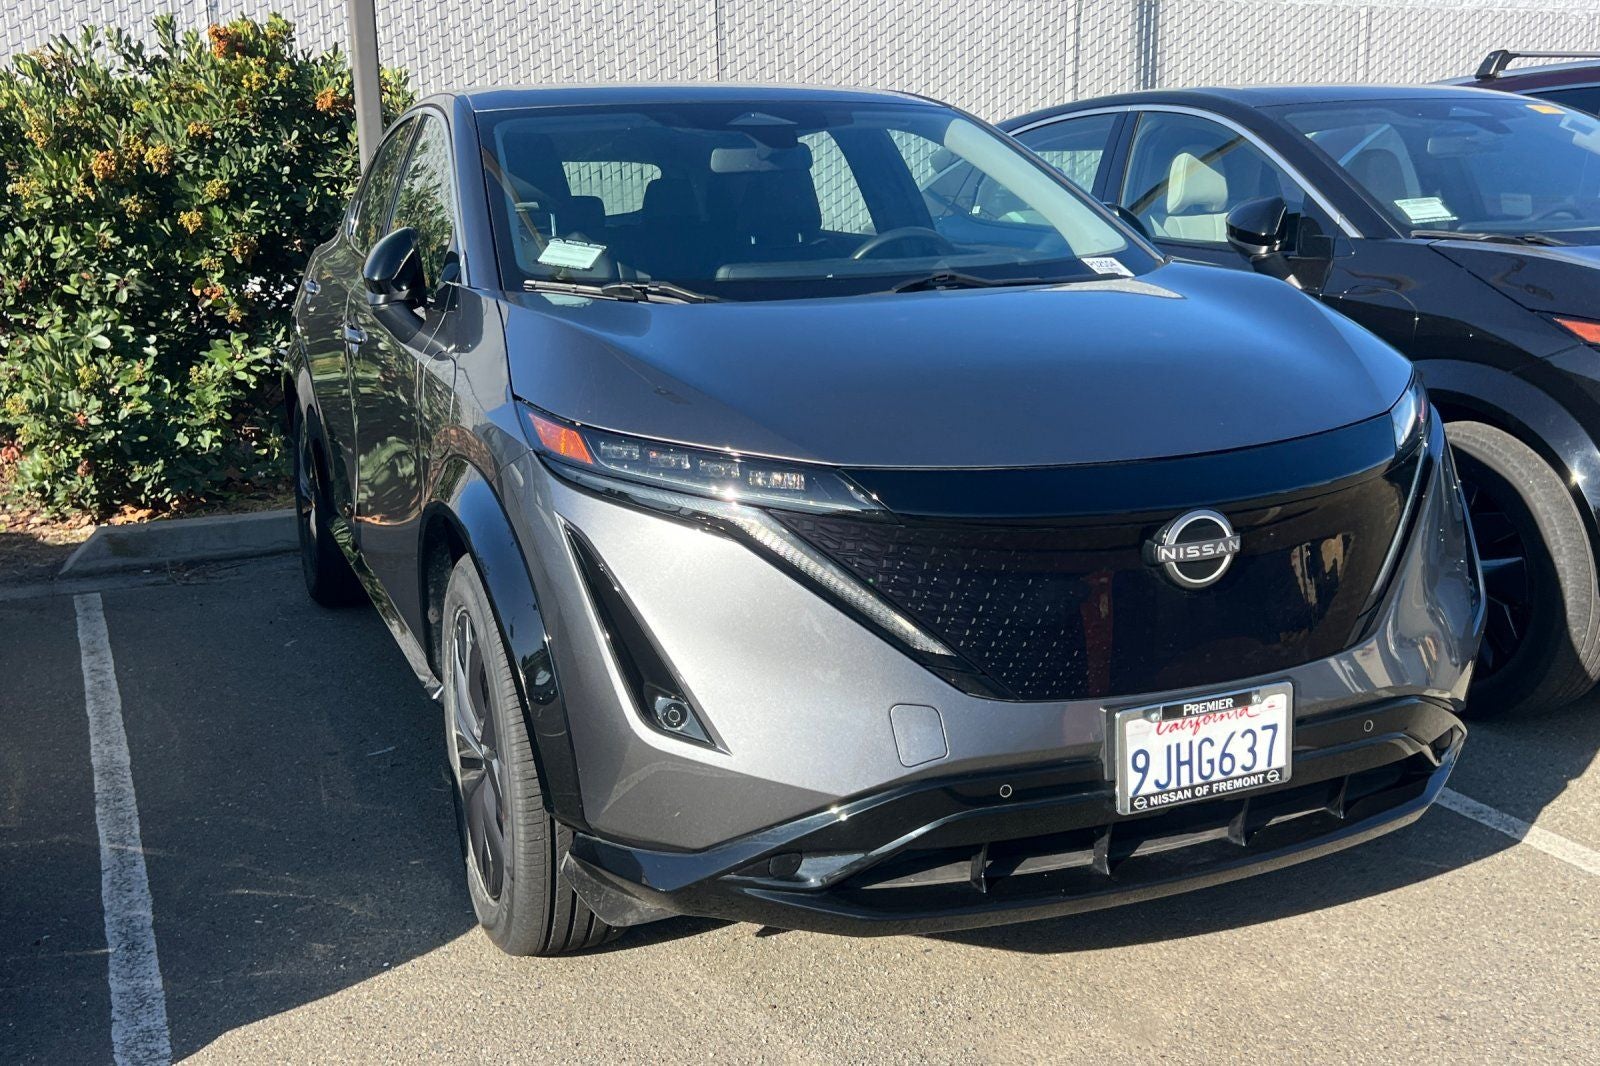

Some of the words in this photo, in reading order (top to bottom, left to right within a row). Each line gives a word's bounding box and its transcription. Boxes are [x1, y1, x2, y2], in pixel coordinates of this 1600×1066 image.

[1161, 540, 1240, 560] NISSAN
[1184, 697, 1233, 716] PREMIER
[1131, 724, 1278, 796] 9JHG637
[1149, 788, 1192, 806] NISSAN
[1195, 785, 1209, 797] OF
[1212, 774, 1264, 793] FREMONT
